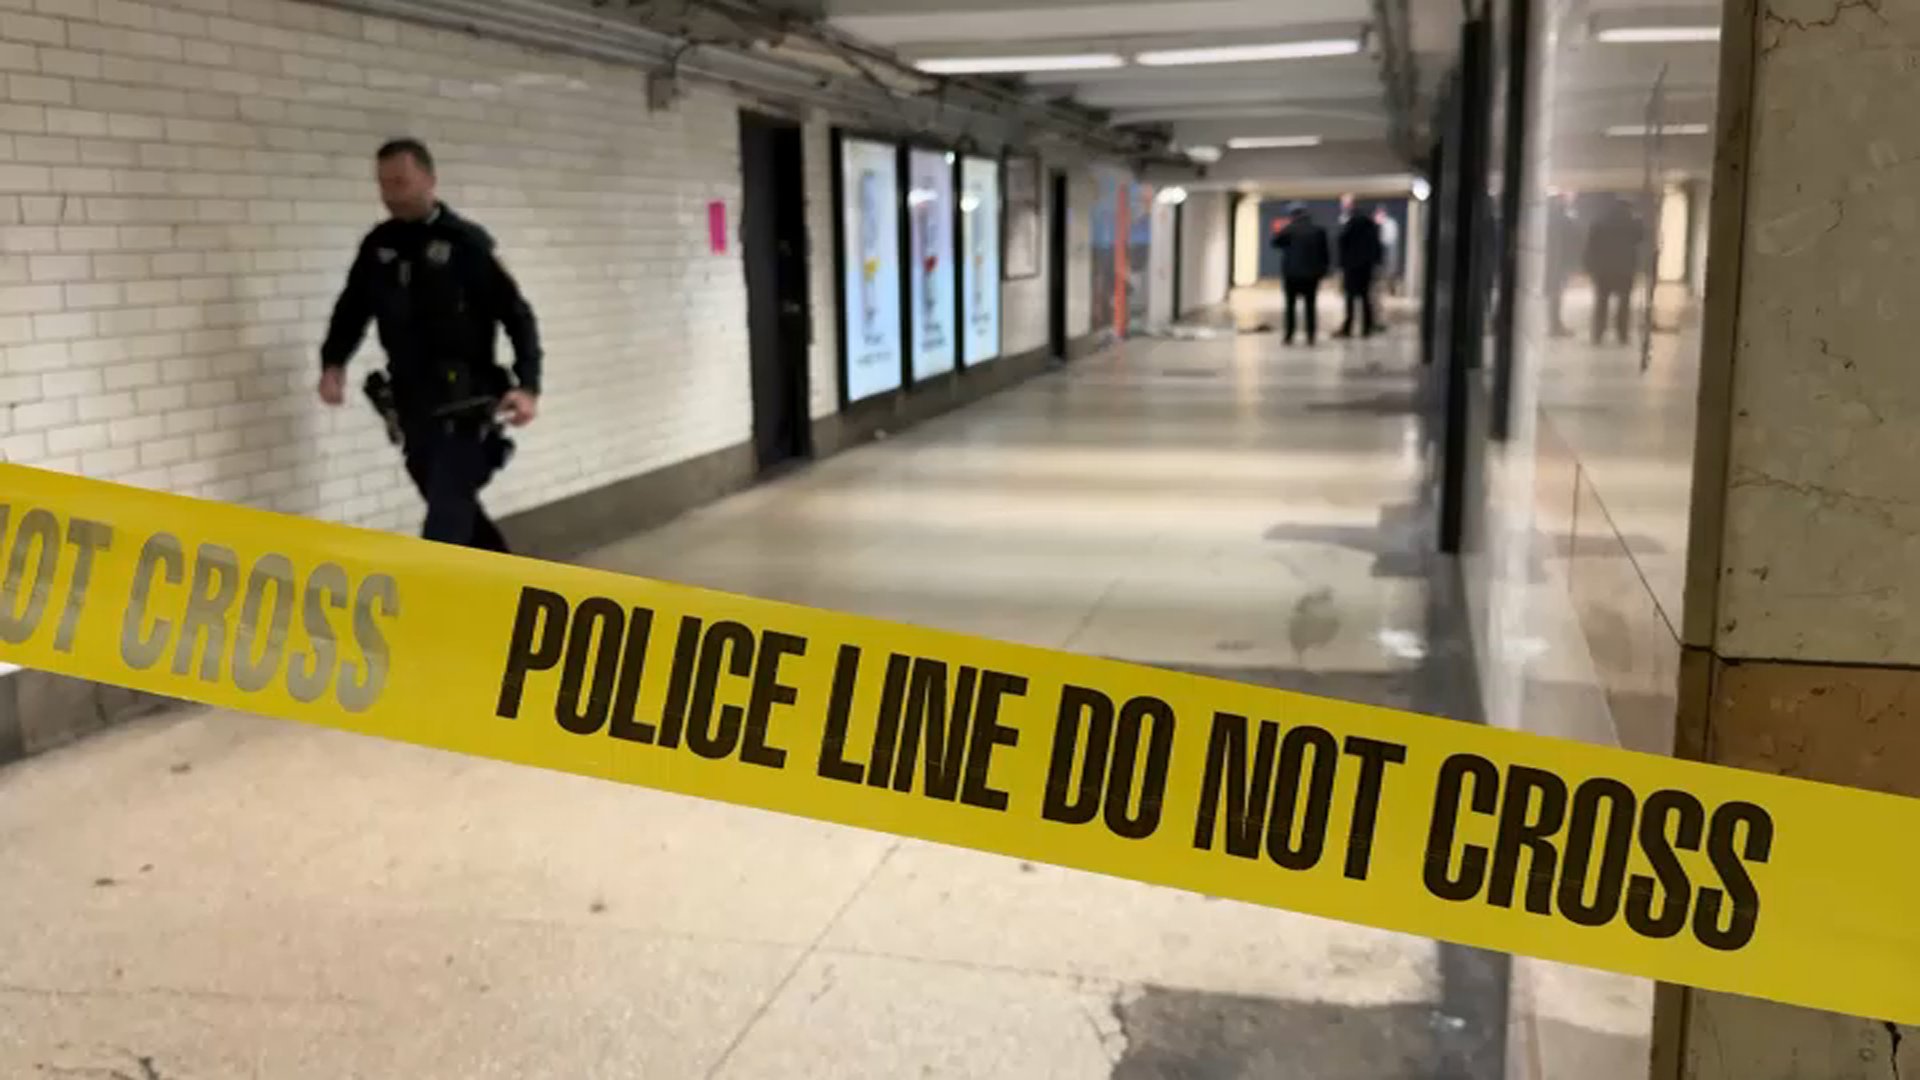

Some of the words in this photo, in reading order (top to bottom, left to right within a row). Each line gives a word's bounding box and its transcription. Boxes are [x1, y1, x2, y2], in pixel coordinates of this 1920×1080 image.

[0, 504, 113, 653] OT
[120, 531, 400, 713] CROSS
[496, 586, 807, 769] POLICE
[817, 643, 1029, 812] LINE
[1041, 683, 1176, 840] DO
[1193, 711, 1408, 881] NOT
[1422, 753, 1774, 951] CROSS
